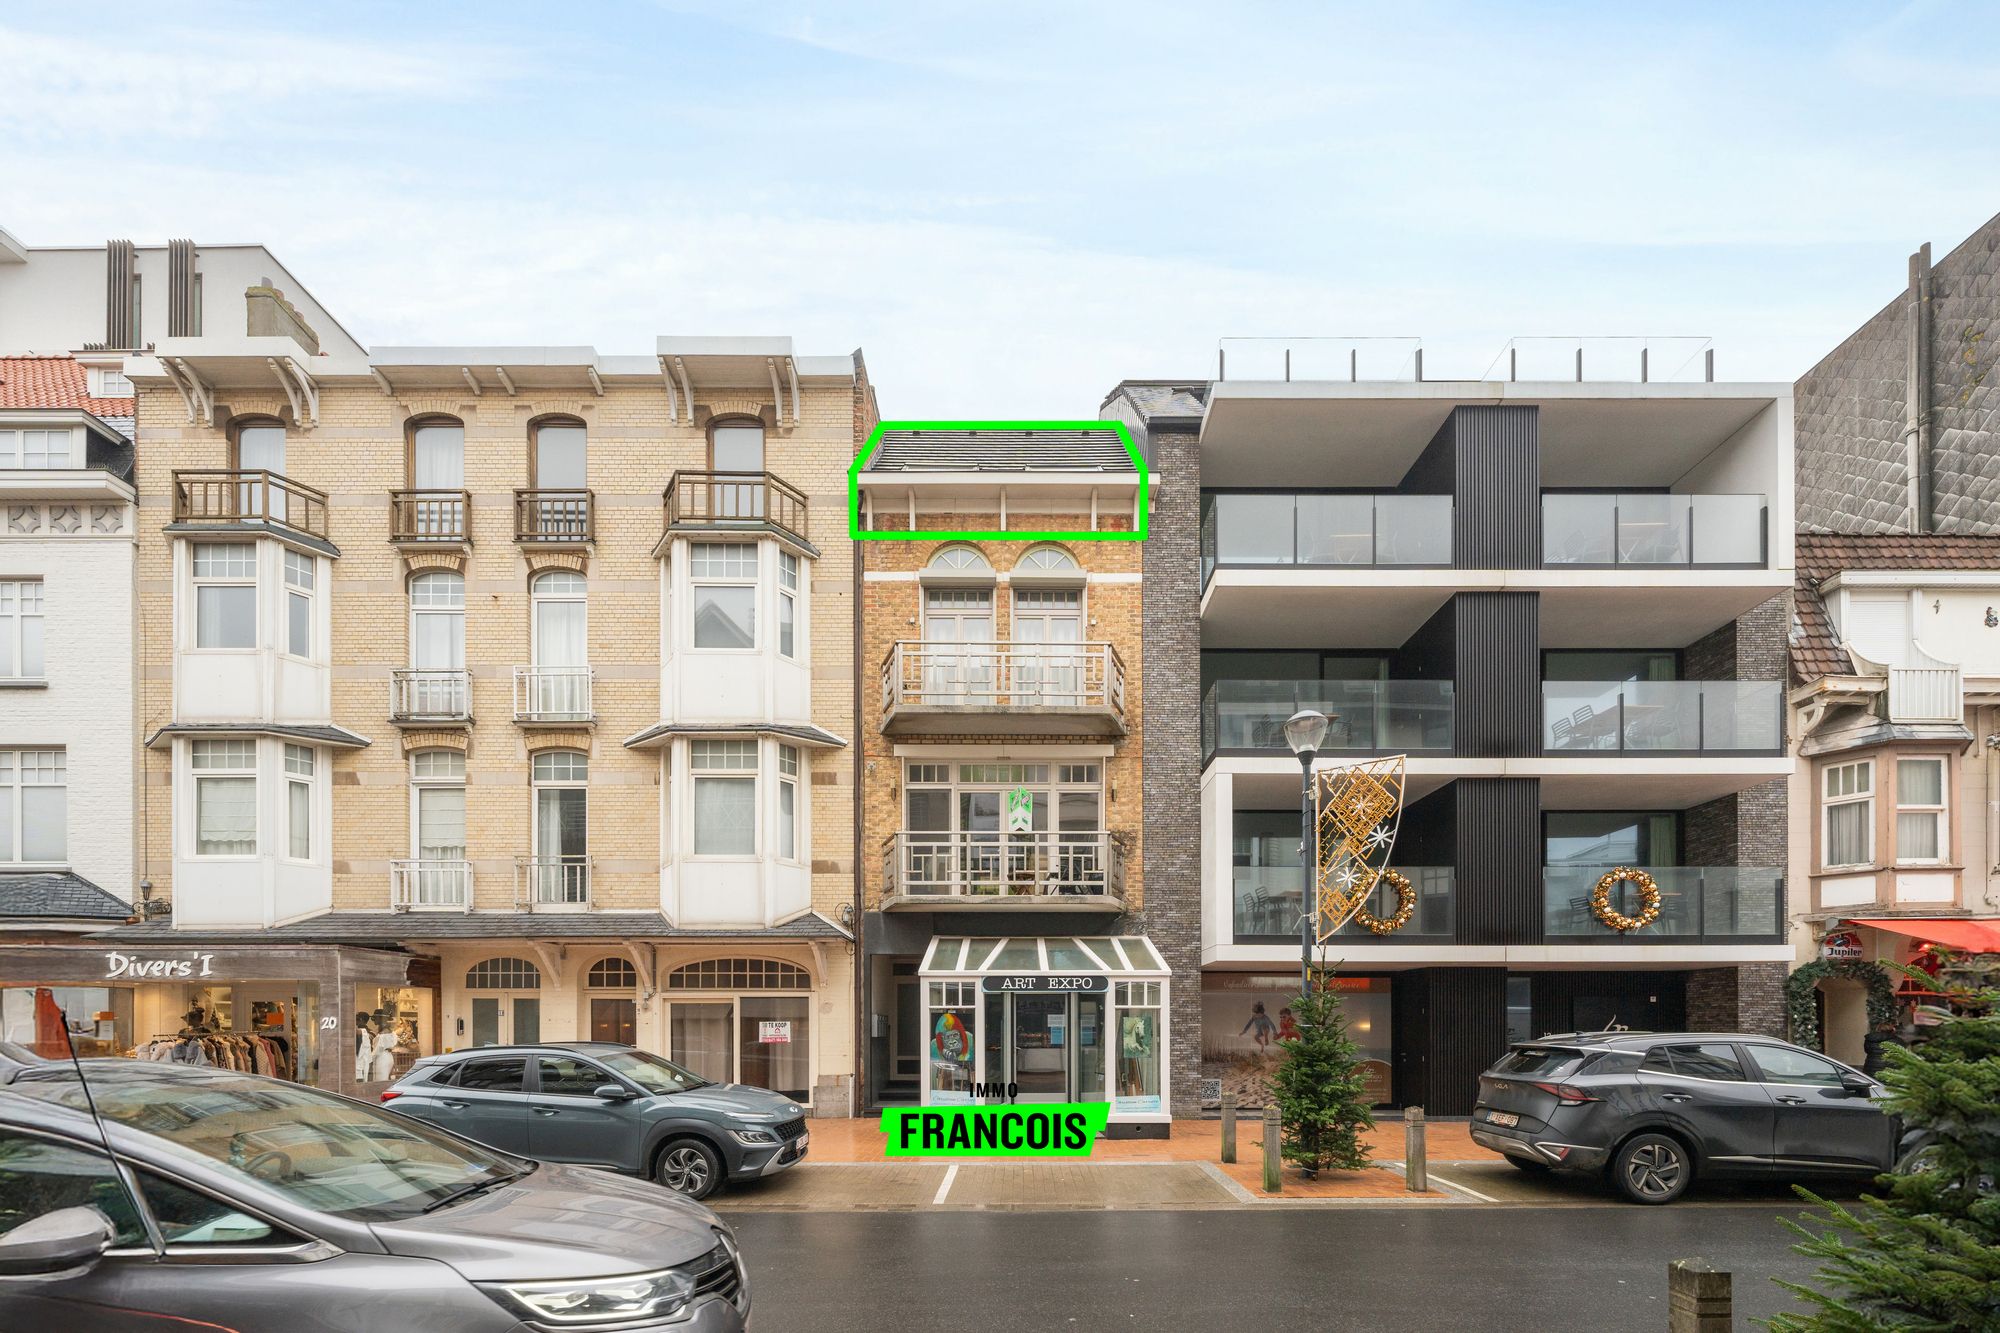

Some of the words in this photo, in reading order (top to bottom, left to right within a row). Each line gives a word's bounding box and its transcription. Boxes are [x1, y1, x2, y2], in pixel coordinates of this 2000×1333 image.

[1828, 948, 1862, 957] Jupiler
[105, 951, 215, 978] Divers'I
[1001, 977, 1036, 989] ART
[1047, 977, 1093, 989] EXPO
[320, 1016, 337, 1030] 20
